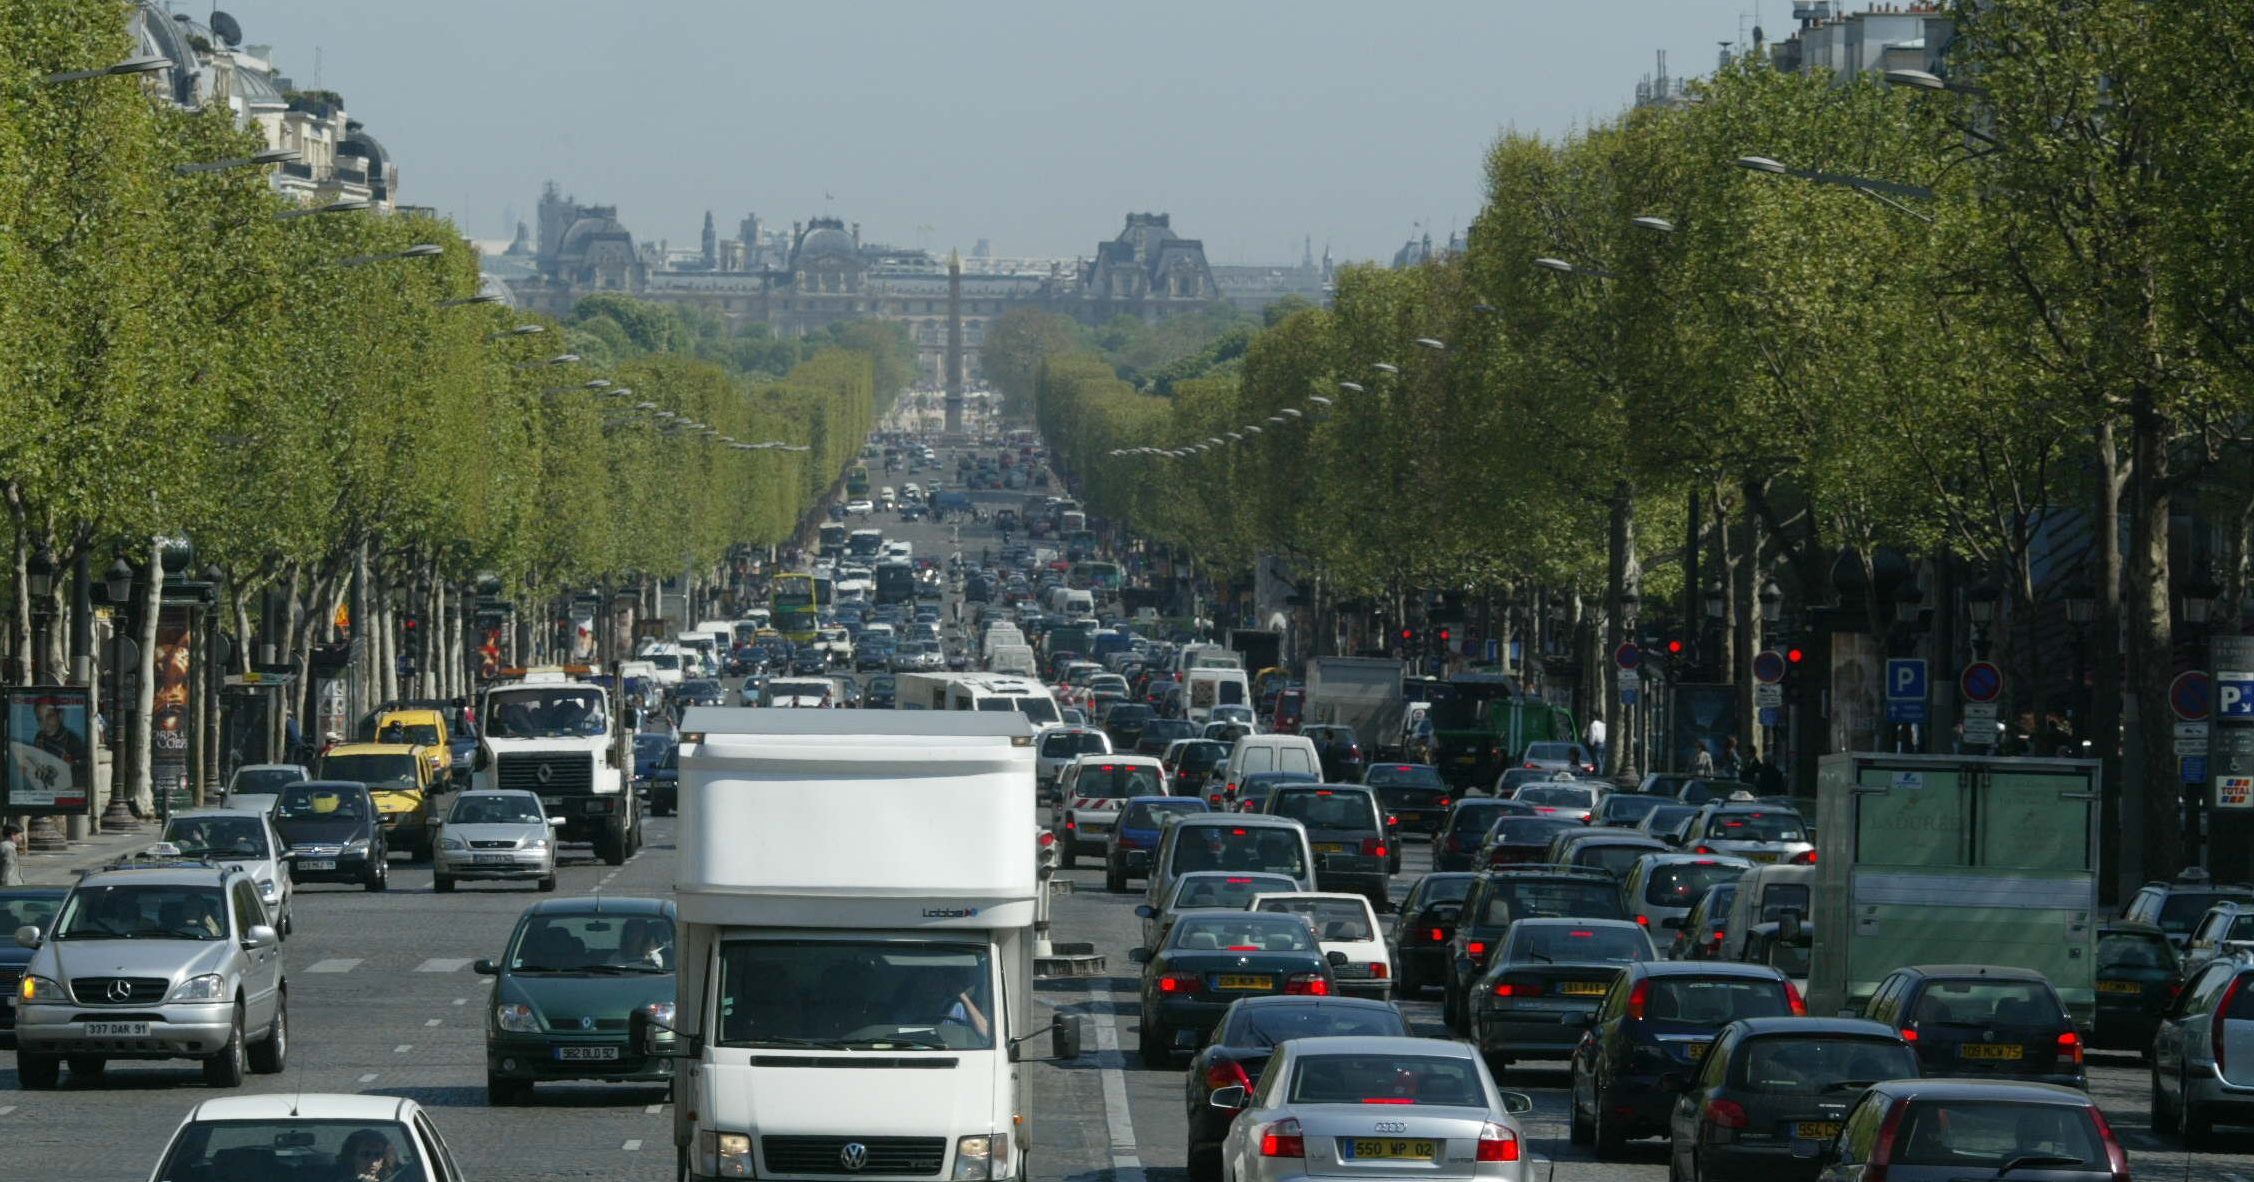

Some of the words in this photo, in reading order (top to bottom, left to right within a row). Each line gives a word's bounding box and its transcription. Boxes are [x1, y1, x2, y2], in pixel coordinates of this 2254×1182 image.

[1898, 667, 1914, 691] P
[2221, 686, 2241, 712] P
[2222, 786, 2250, 796] TOTAL
[1356, 1142, 1382, 1155] 550
[1390, 1143, 1407, 1155] WP
[1415, 1143, 1432, 1155] 02
